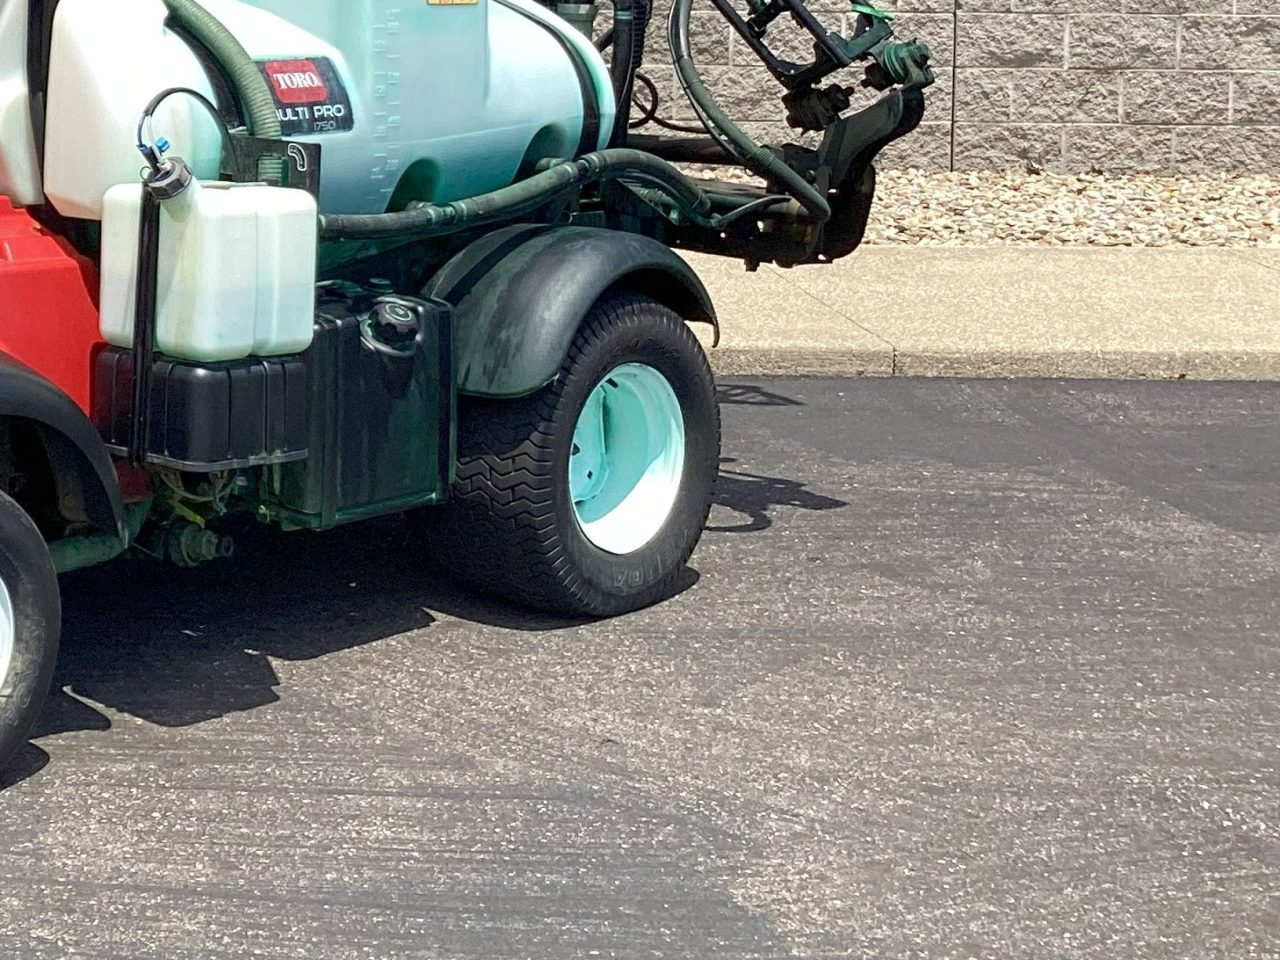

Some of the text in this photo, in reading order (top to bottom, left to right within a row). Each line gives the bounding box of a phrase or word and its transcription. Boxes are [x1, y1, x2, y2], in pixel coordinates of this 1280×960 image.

[273, 72, 318, 89] TORO
[313, 105, 344, 118] PRO
[313, 121, 336, 131] 1750
